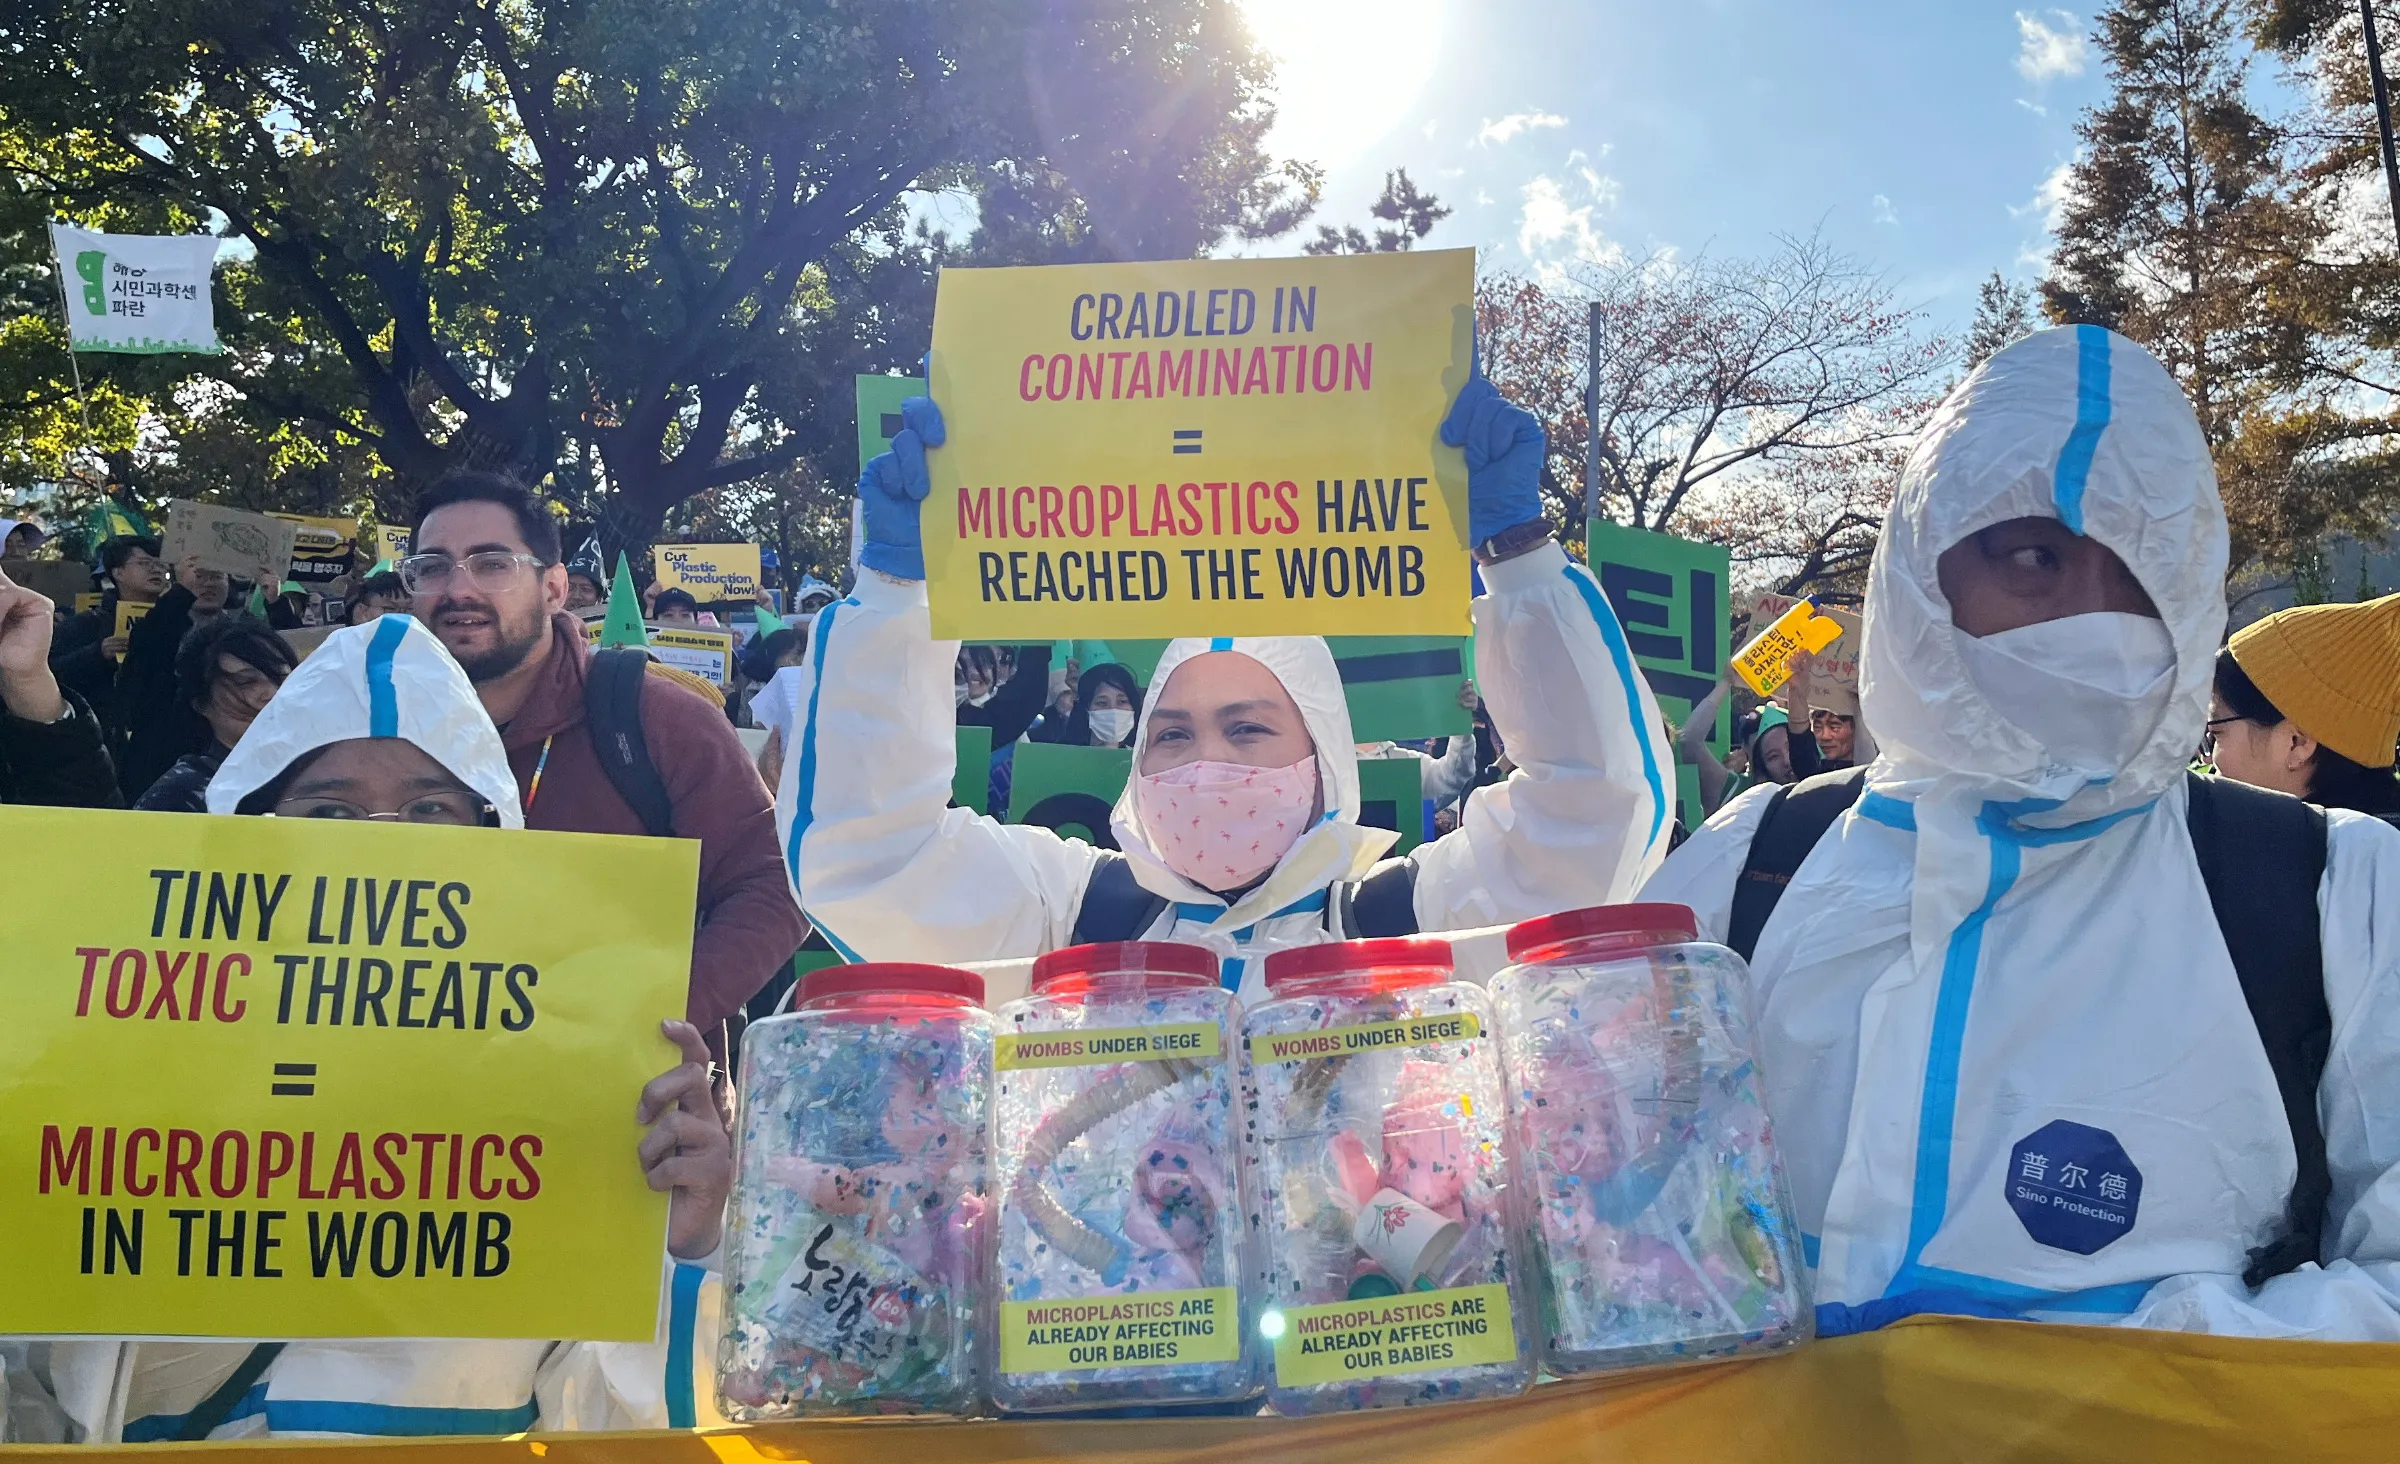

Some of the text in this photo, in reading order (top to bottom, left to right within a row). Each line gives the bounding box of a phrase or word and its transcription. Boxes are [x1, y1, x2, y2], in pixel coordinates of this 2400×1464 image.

[111, 299, 146, 318] 파란
[1070, 285, 1317, 341] CRADLED IN
[1019, 342, 1373, 402] CONTAMINATION
[957, 477, 1430, 539] MICROPLASTICS HAVE
[664, 551, 688, 562] Cut
[672, 561, 717, 573] Plastic
[978, 545, 1425, 602] REACHED THE WOMB
[680, 573, 753, 584] Production
[723, 583, 755, 595] Now!
[1743, 628, 1783, 668] 플라스틱
[149, 869, 471, 950] TINY LIVES
[75, 947, 539, 1032] TOXIC THREATS
[1015, 1032, 1201, 1059] WOMBS UNDER SIEGE
[1271, 1020, 1461, 1057] WOMBS UNDER SIEGE
[38, 1124, 543, 1201] MICROPLASTICS
[2020, 1151, 2129, 1201] 普尔德
[2015, 1185, 2126, 1225] Sino Protection
[80, 1207, 512, 1279] IN THE WOMB
[1026, 1298, 1215, 1325] MICROPLASTICS ARE
[1297, 1297, 1486, 1335] MICROPLASTICS ARE
[1026, 1318, 1215, 1346] ALREADY AFFECTING
[1300, 1317, 1489, 1355] ALREADY AFFECTING
[1068, 1341, 1178, 1364] OUR BABIES
[1342, 1342, 1455, 1371] OUR BABIES
